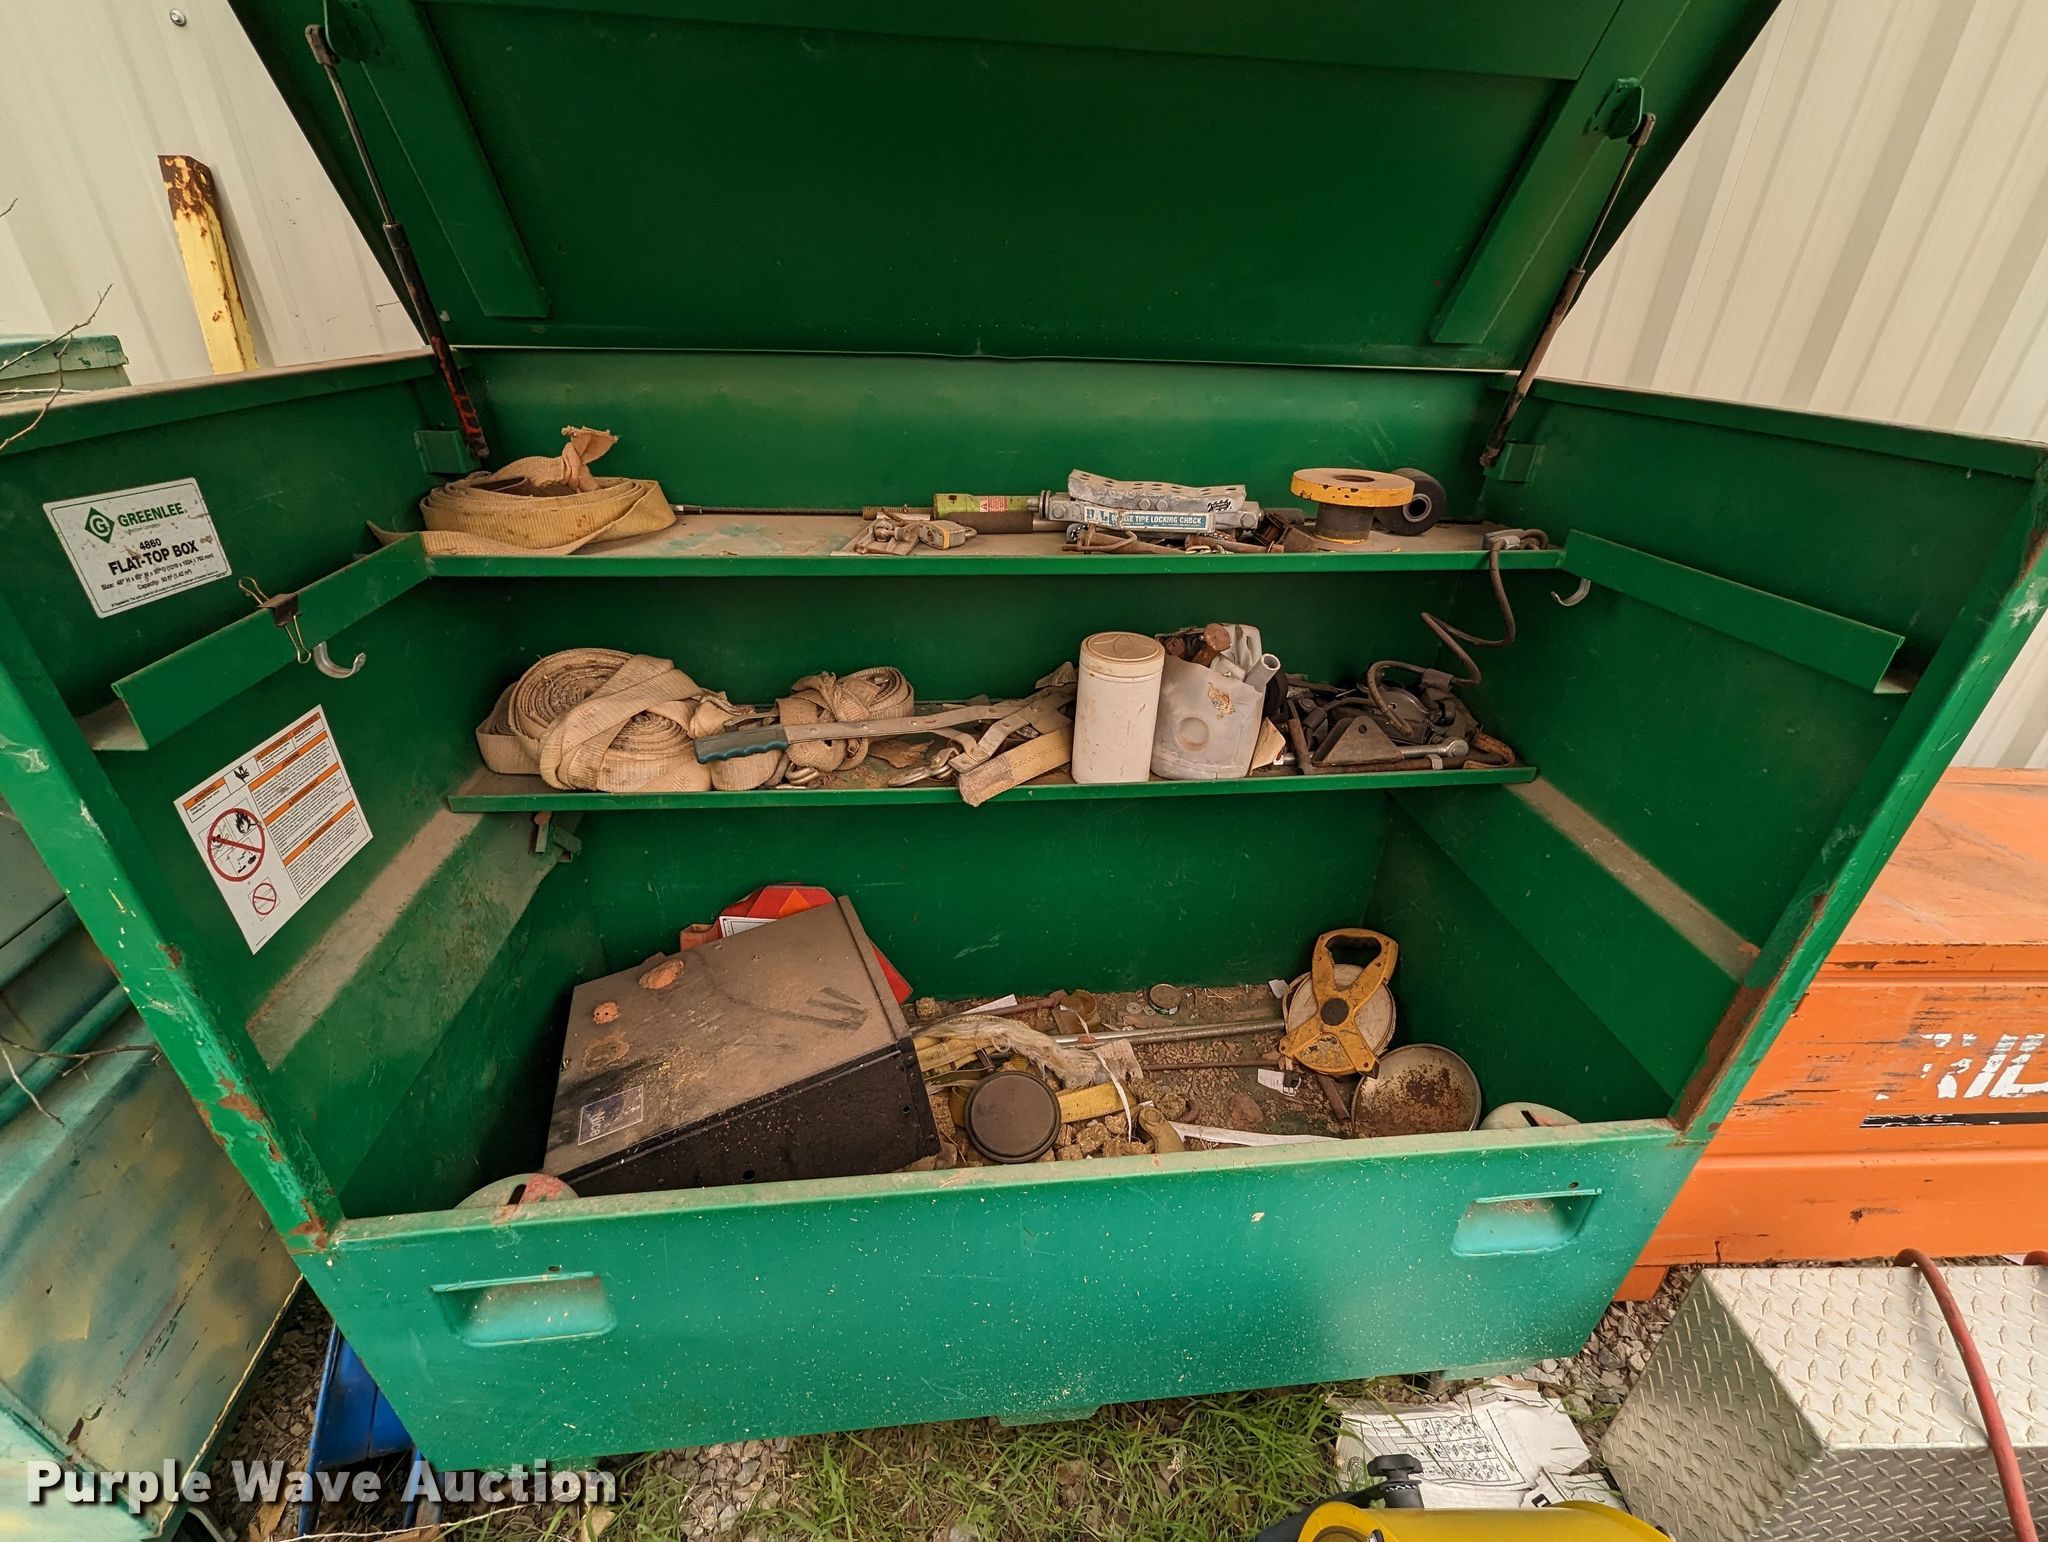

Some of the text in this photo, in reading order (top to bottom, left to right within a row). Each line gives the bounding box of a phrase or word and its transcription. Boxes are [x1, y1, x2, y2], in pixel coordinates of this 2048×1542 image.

[117, 502, 185, 527] GREENLEE
[1150, 515, 1178, 524] LOCKING
[108, 540, 200, 576] FLAT-TOP BOX
